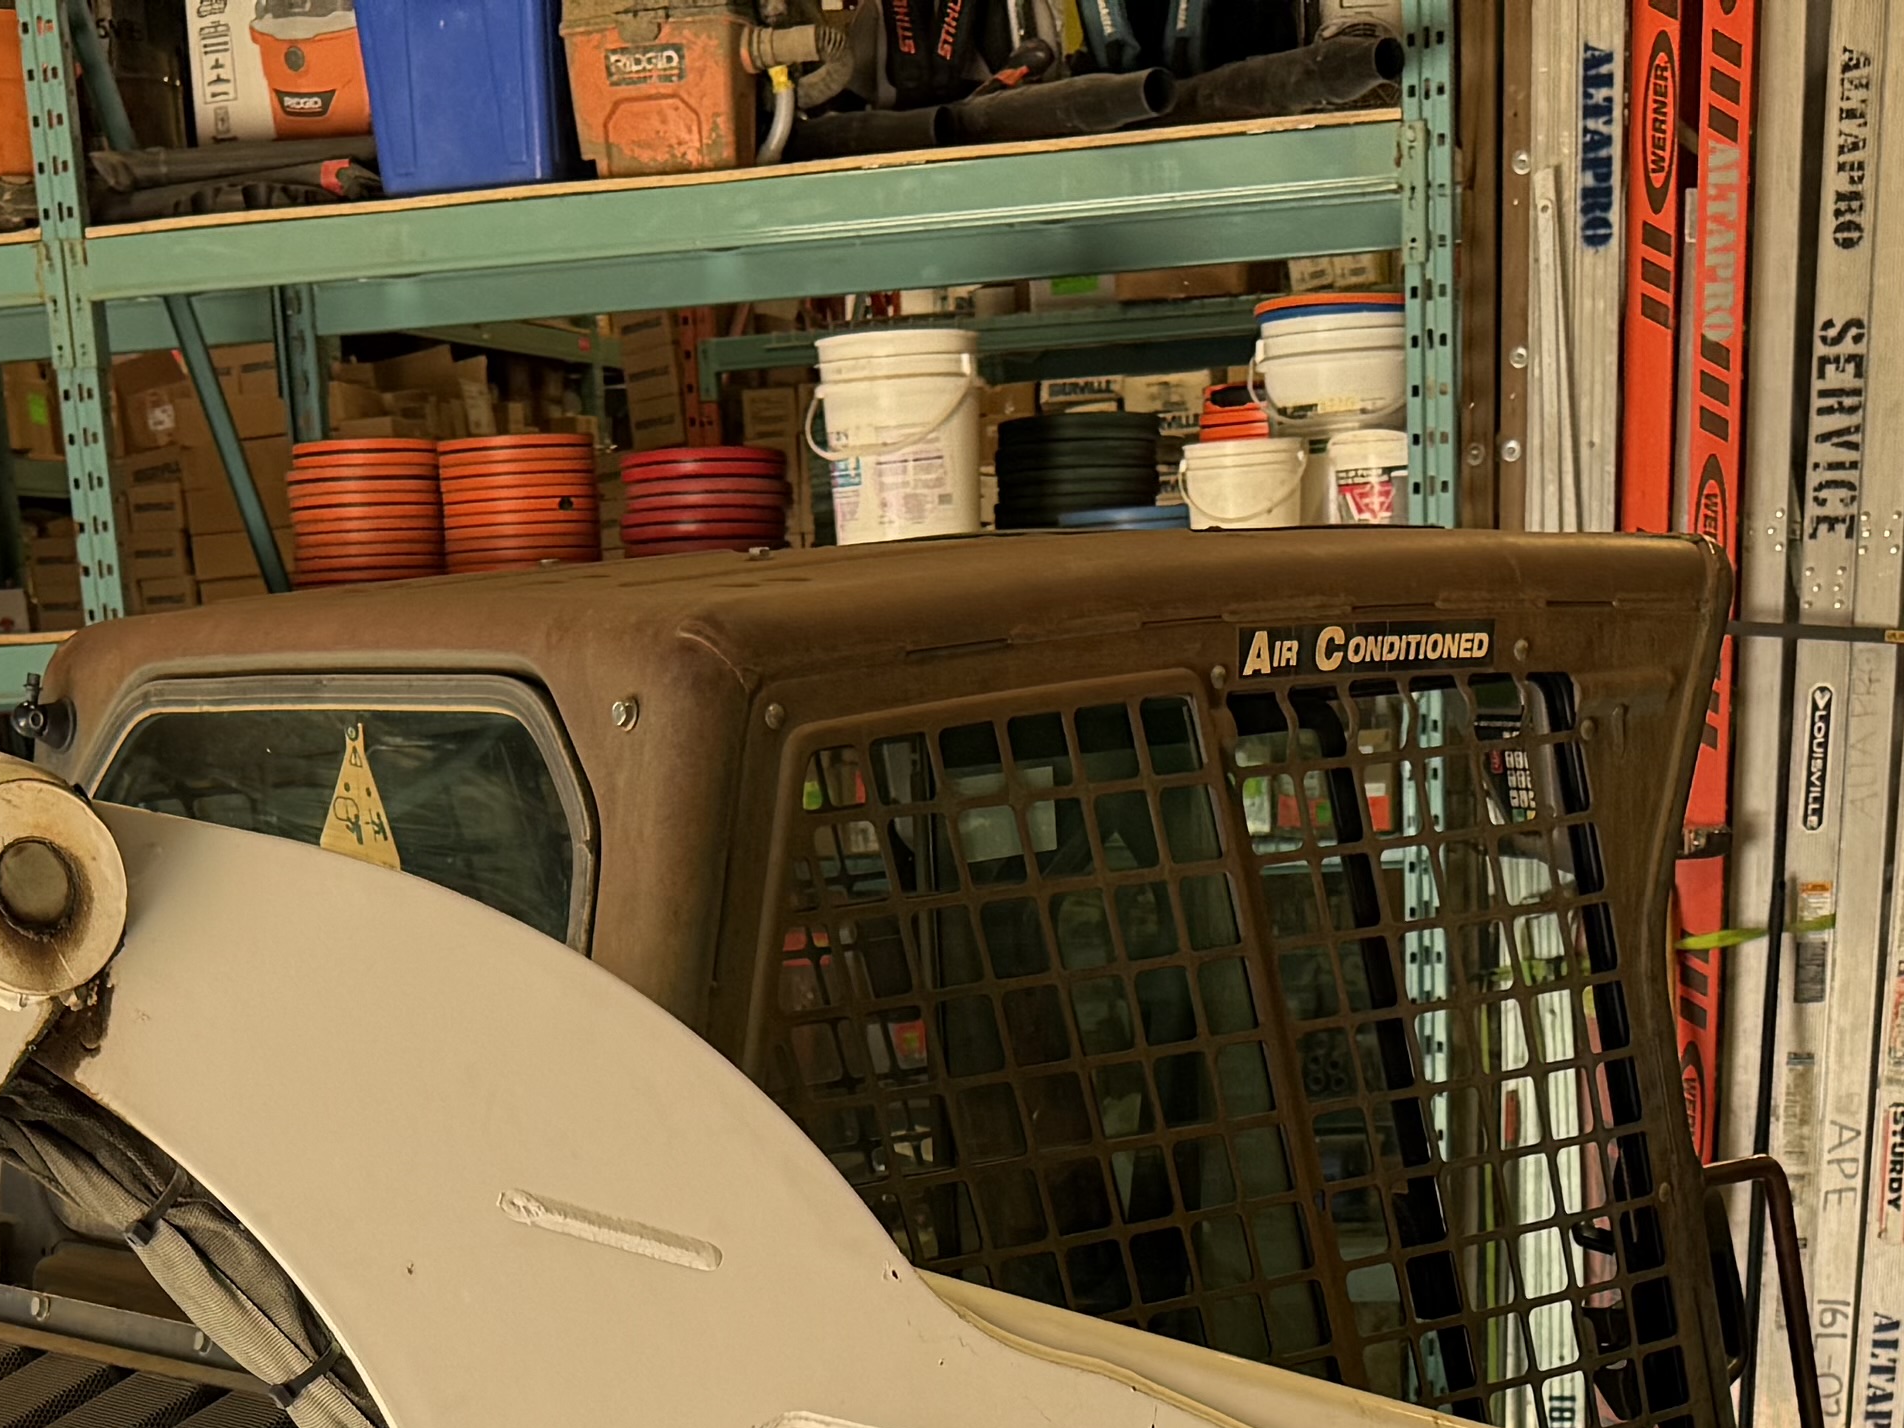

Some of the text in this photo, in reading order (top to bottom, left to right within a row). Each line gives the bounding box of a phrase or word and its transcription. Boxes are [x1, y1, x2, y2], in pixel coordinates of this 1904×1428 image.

[609, 49, 679, 73] RIDGID
[1580, 42, 1615, 249] ALTAPRO
[1648, 59, 1670, 176] WERNER
[1832, 45, 1873, 250] ALTAPRO
[1701, 141, 1741, 342] ALTAPRO
[1808, 316, 1867, 540] SERVICE
[1806, 711, 1827, 830] LOUISVILLE
